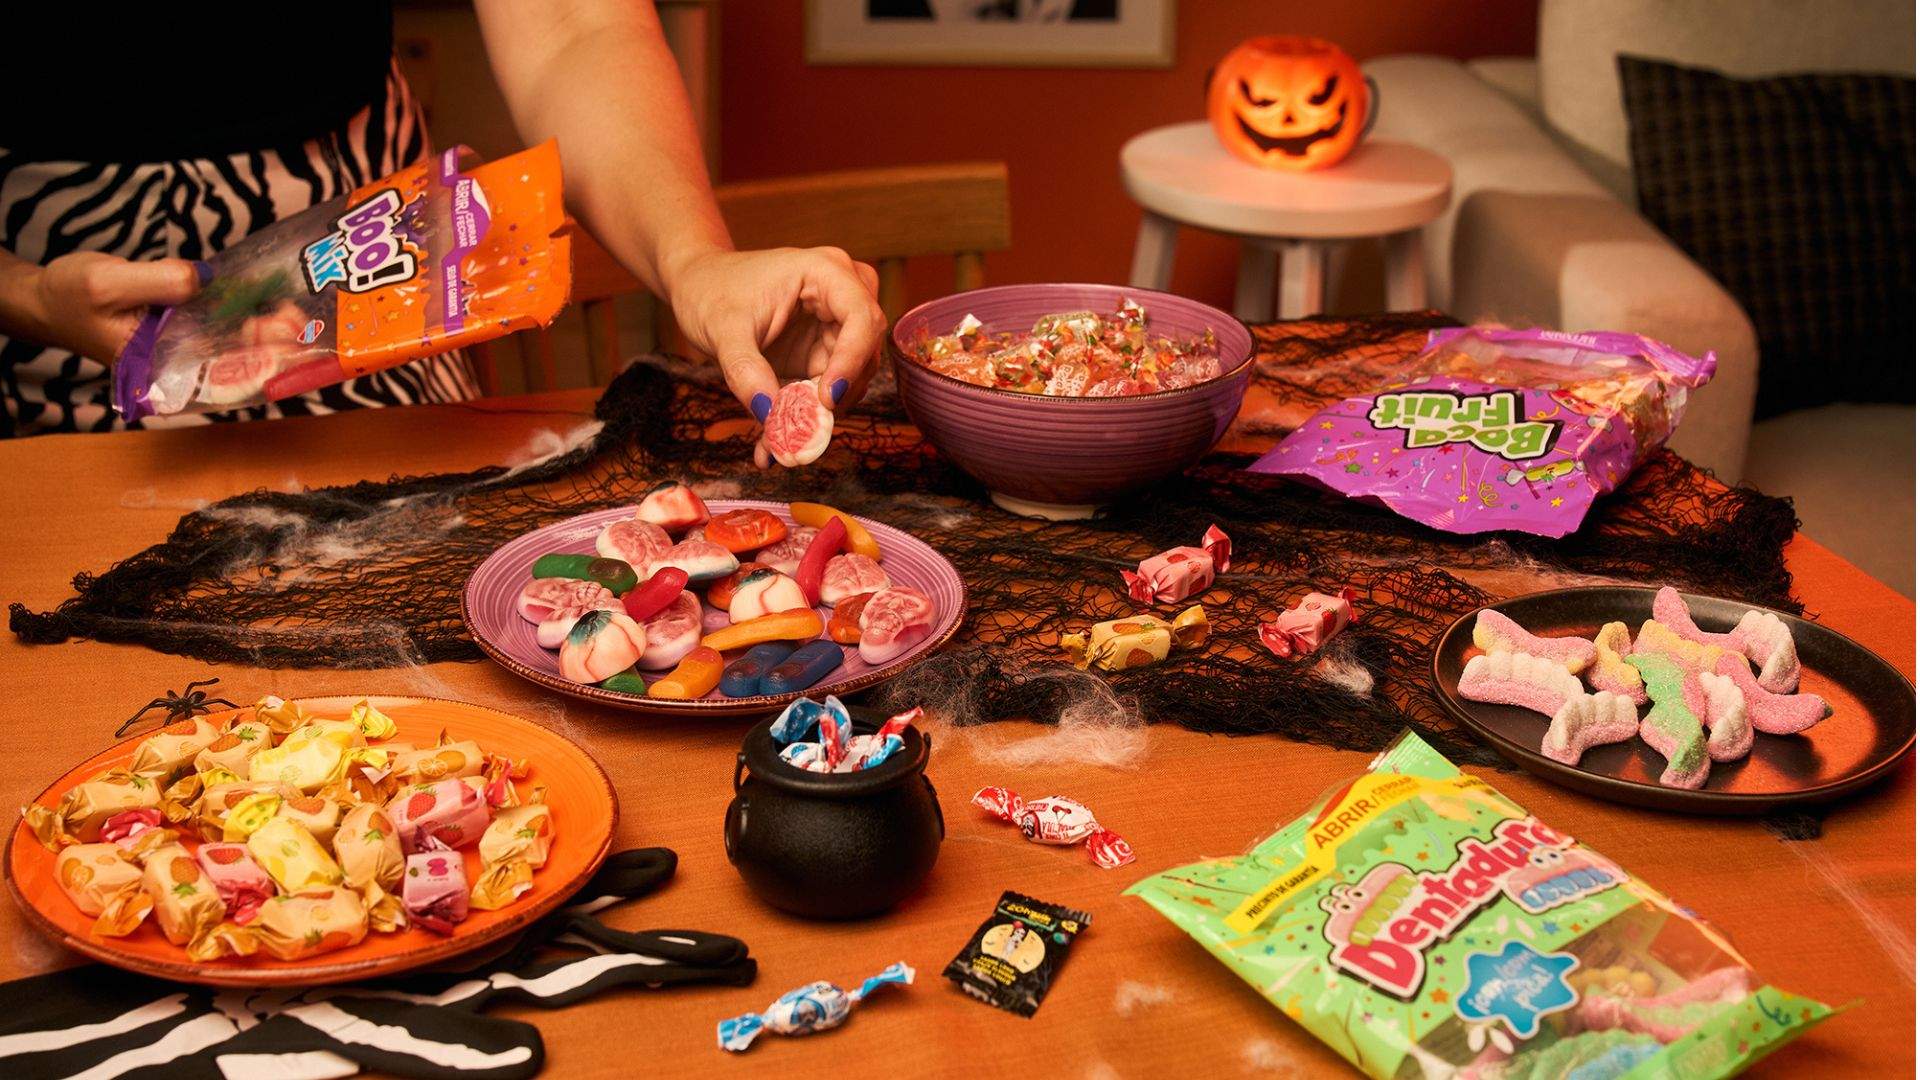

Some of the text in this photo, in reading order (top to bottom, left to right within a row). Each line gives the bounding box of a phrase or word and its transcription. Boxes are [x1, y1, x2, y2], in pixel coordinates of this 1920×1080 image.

[456, 215, 468, 248] FECHAR
[465, 212, 477, 247] CERRAR
[1377, 396, 1510, 428] Fruit
[1413, 423, 1550, 456] Boca
